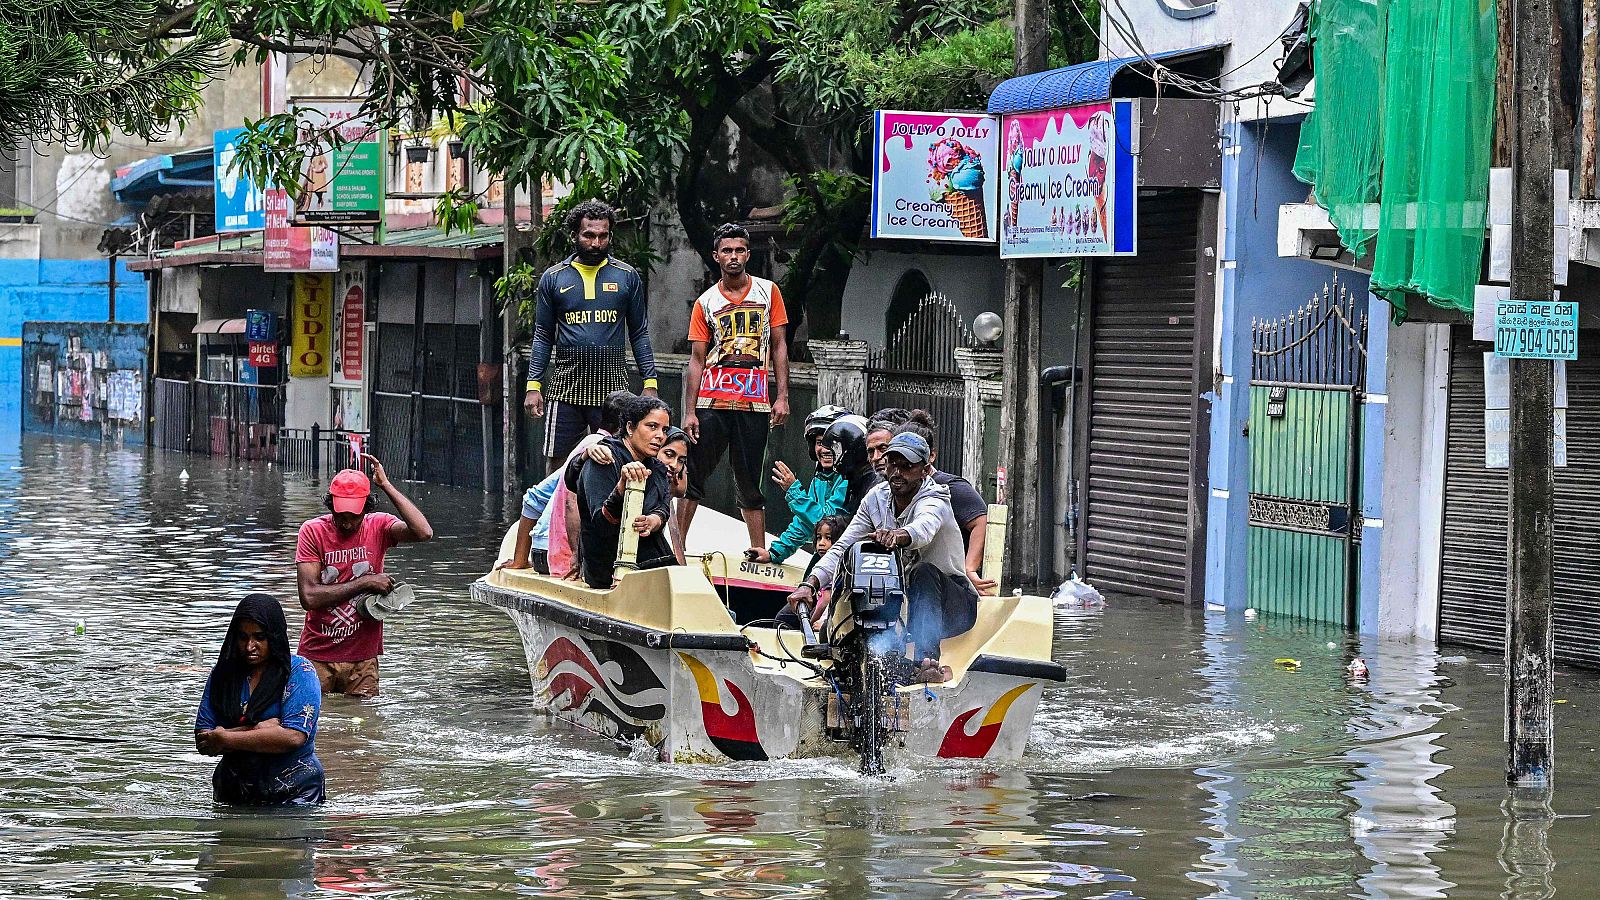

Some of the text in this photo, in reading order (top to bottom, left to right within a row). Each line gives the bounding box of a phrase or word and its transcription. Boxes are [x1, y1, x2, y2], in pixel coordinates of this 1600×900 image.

[892, 122, 990, 138] JOLLY O JOLLY
[1024, 144, 1082, 168] JOLLY O JOLLY
[1008, 173, 1100, 206] Creamy Ice Cream
[275, 195, 287, 210] Lank
[896, 198, 953, 215] Creamy
[273, 214, 290, 228] Netw
[888, 213, 960, 228] Ice Cream
[301, 273, 323, 366] STUDIO
[565, 310, 617, 325] GREAT BOYS
[1498, 328, 1574, 353] 077 904 0503
[251, 345, 275, 354] airtel
[256, 354, 270, 363] 4G
[324, 546, 368, 565] MORTEM
[861, 556, 890, 568] 25
[739, 561, 785, 580] SNL-514
